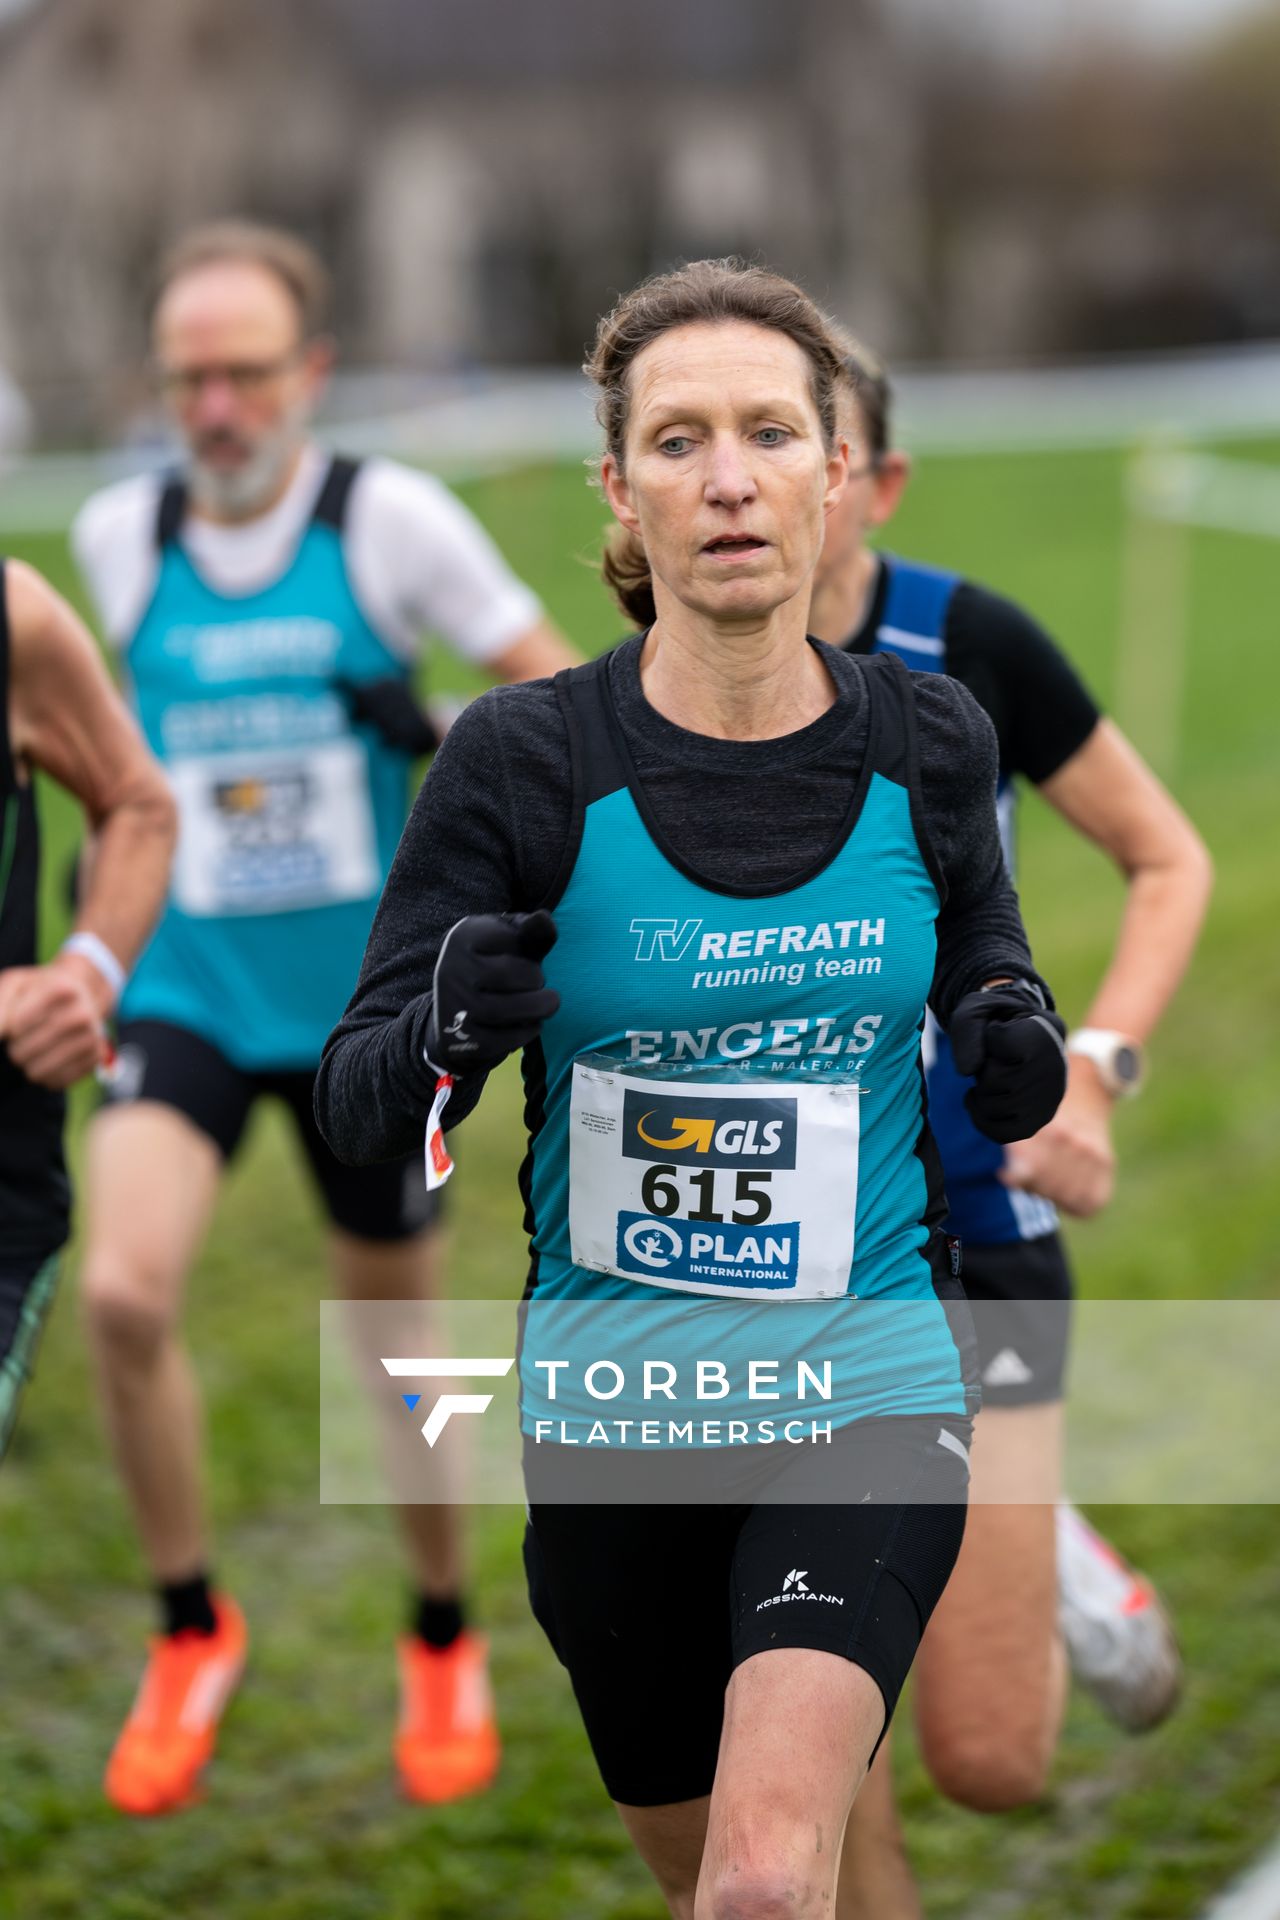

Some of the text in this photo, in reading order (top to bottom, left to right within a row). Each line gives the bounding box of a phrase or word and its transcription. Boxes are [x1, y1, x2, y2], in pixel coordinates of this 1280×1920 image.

[629, 917, 886, 961] TV REFRATH
[691, 956, 882, 989] running team
[625, 1014, 883, 1064] ENGELS
[714, 1119, 783, 1155] GLS
[641, 1164, 772, 1226] 615
[689, 1232, 792, 1266] PLAN
[689, 1264, 790, 1281] INTERNATIONAL
[756, 1592, 844, 1612] KOSSMANN
